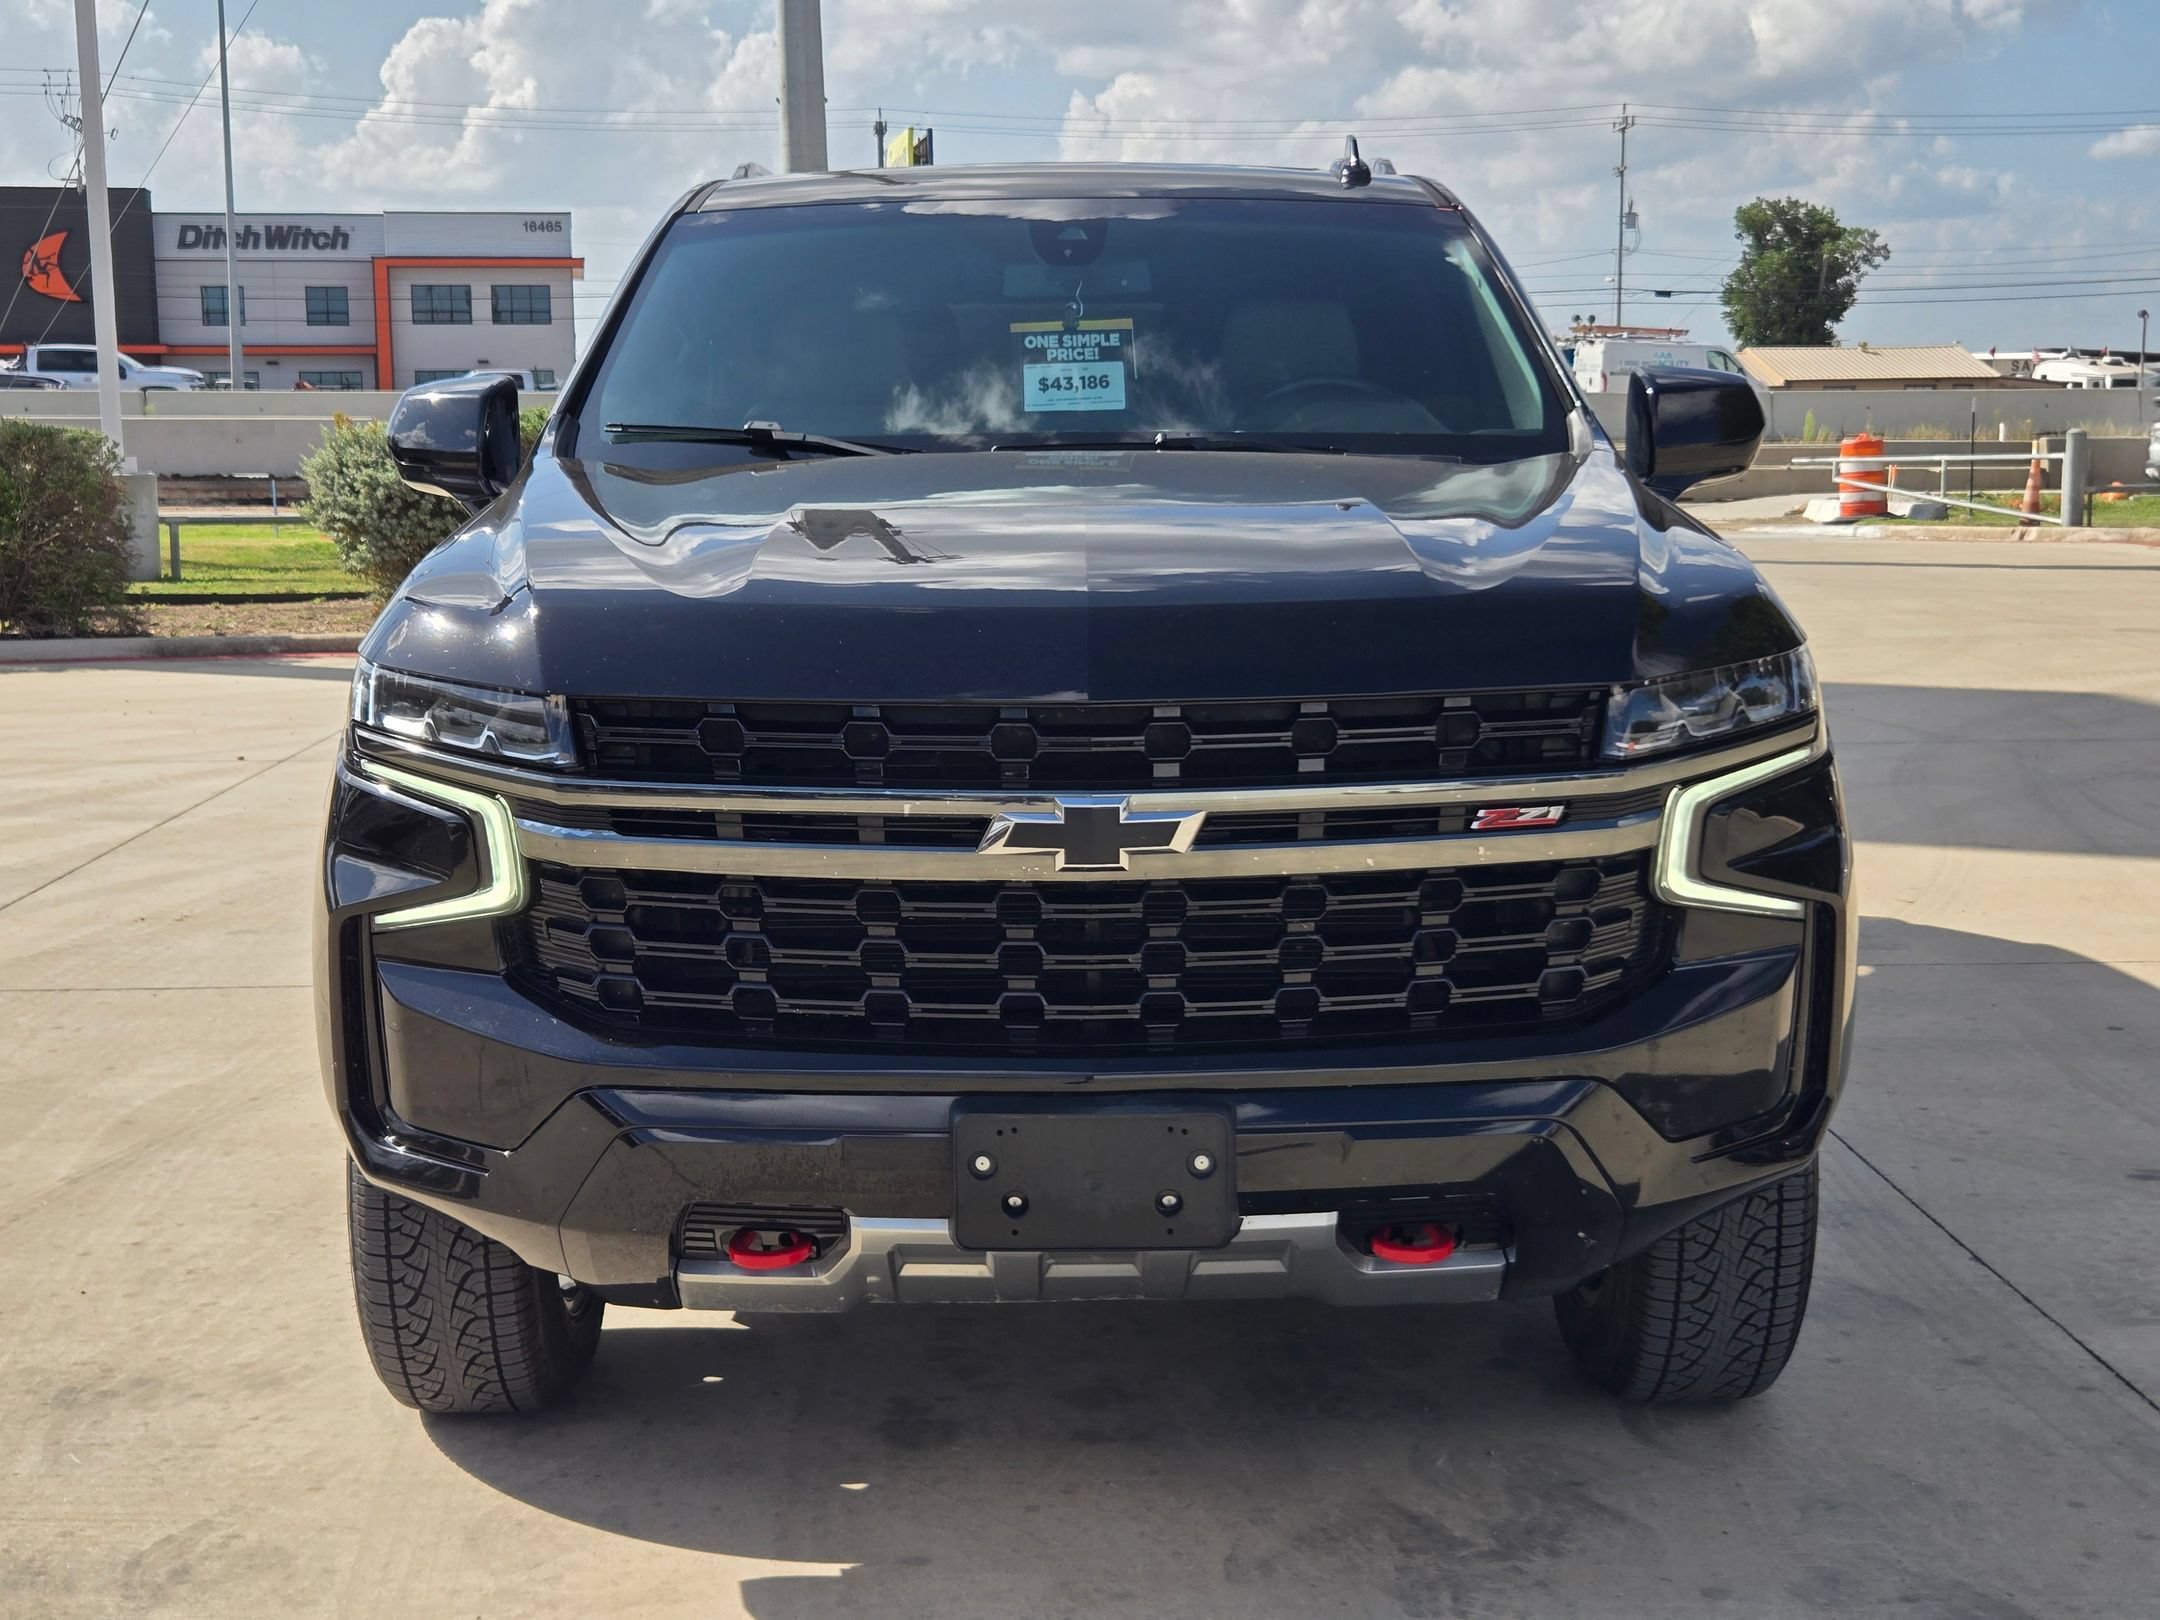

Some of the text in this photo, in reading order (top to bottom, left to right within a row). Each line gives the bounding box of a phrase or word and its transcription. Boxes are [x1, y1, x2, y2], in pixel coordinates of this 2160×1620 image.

[522, 220, 563, 233] 16465
[177, 224, 350, 250] Ditch Witch
[1023, 333, 1121, 349] ONE SIMPLE
[1046, 347, 1100, 362] PRICE!
[1038, 374, 1110, 394] $43,186
[1470, 805, 1565, 829] Z71
